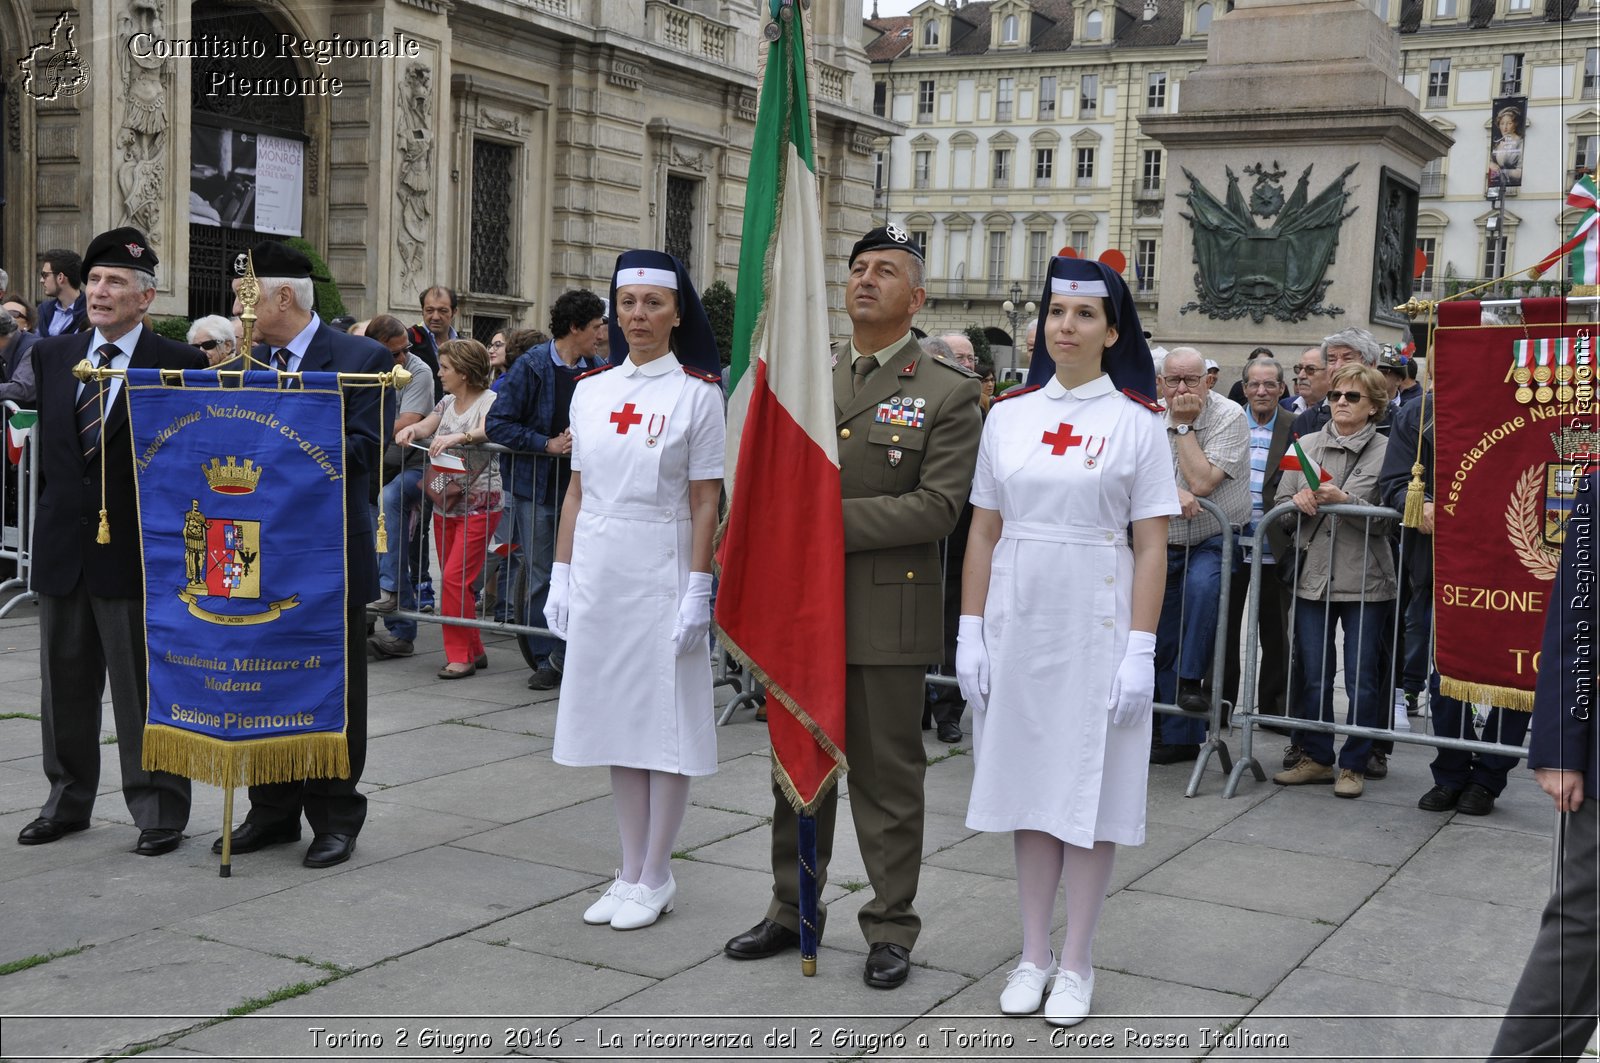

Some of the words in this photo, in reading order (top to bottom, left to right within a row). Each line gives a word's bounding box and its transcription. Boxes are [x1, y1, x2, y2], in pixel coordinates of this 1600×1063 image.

[258, 137, 301, 154] MARILYN
[258, 149, 301, 166] MONROE
[266, 163, 287, 172] DONNA
[136, 410, 201, 474] Associazione
[206, 404, 279, 429] Nazionale
[280, 425, 343, 481] ex-allievi
[1443, 415, 1526, 517] Associazione
[1442, 584, 1544, 613] SEZIONE
[164, 650, 227, 671] Accademia
[232, 657, 300, 672] Militare
[304, 655, 321, 668] di
[204, 675, 262, 692] Modena
[171, 703, 221, 728] Sezione
[223, 711, 315, 730] Piemonte
